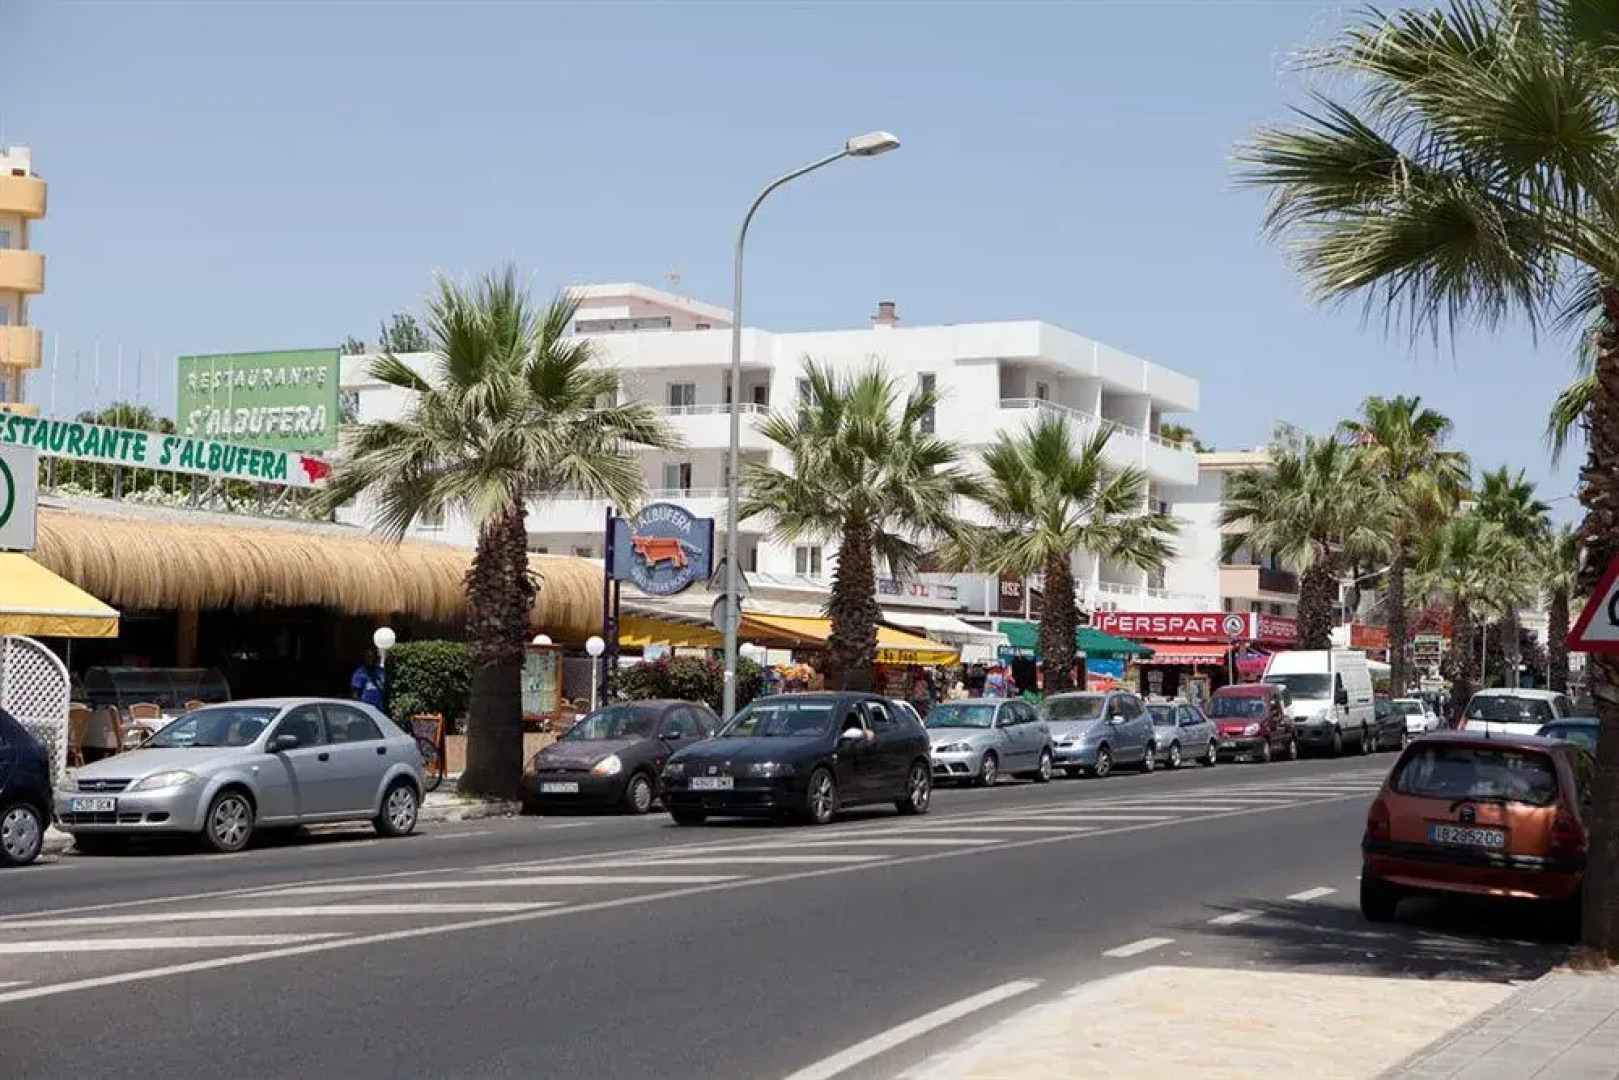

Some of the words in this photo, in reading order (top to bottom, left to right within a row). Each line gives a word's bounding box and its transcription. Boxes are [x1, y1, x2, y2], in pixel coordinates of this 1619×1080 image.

[186, 366, 327, 388] RESTAURANTE
[186, 405, 326, 434] S'ALBUFERA
[160, 436, 287, 480] S'ALBUFERA
